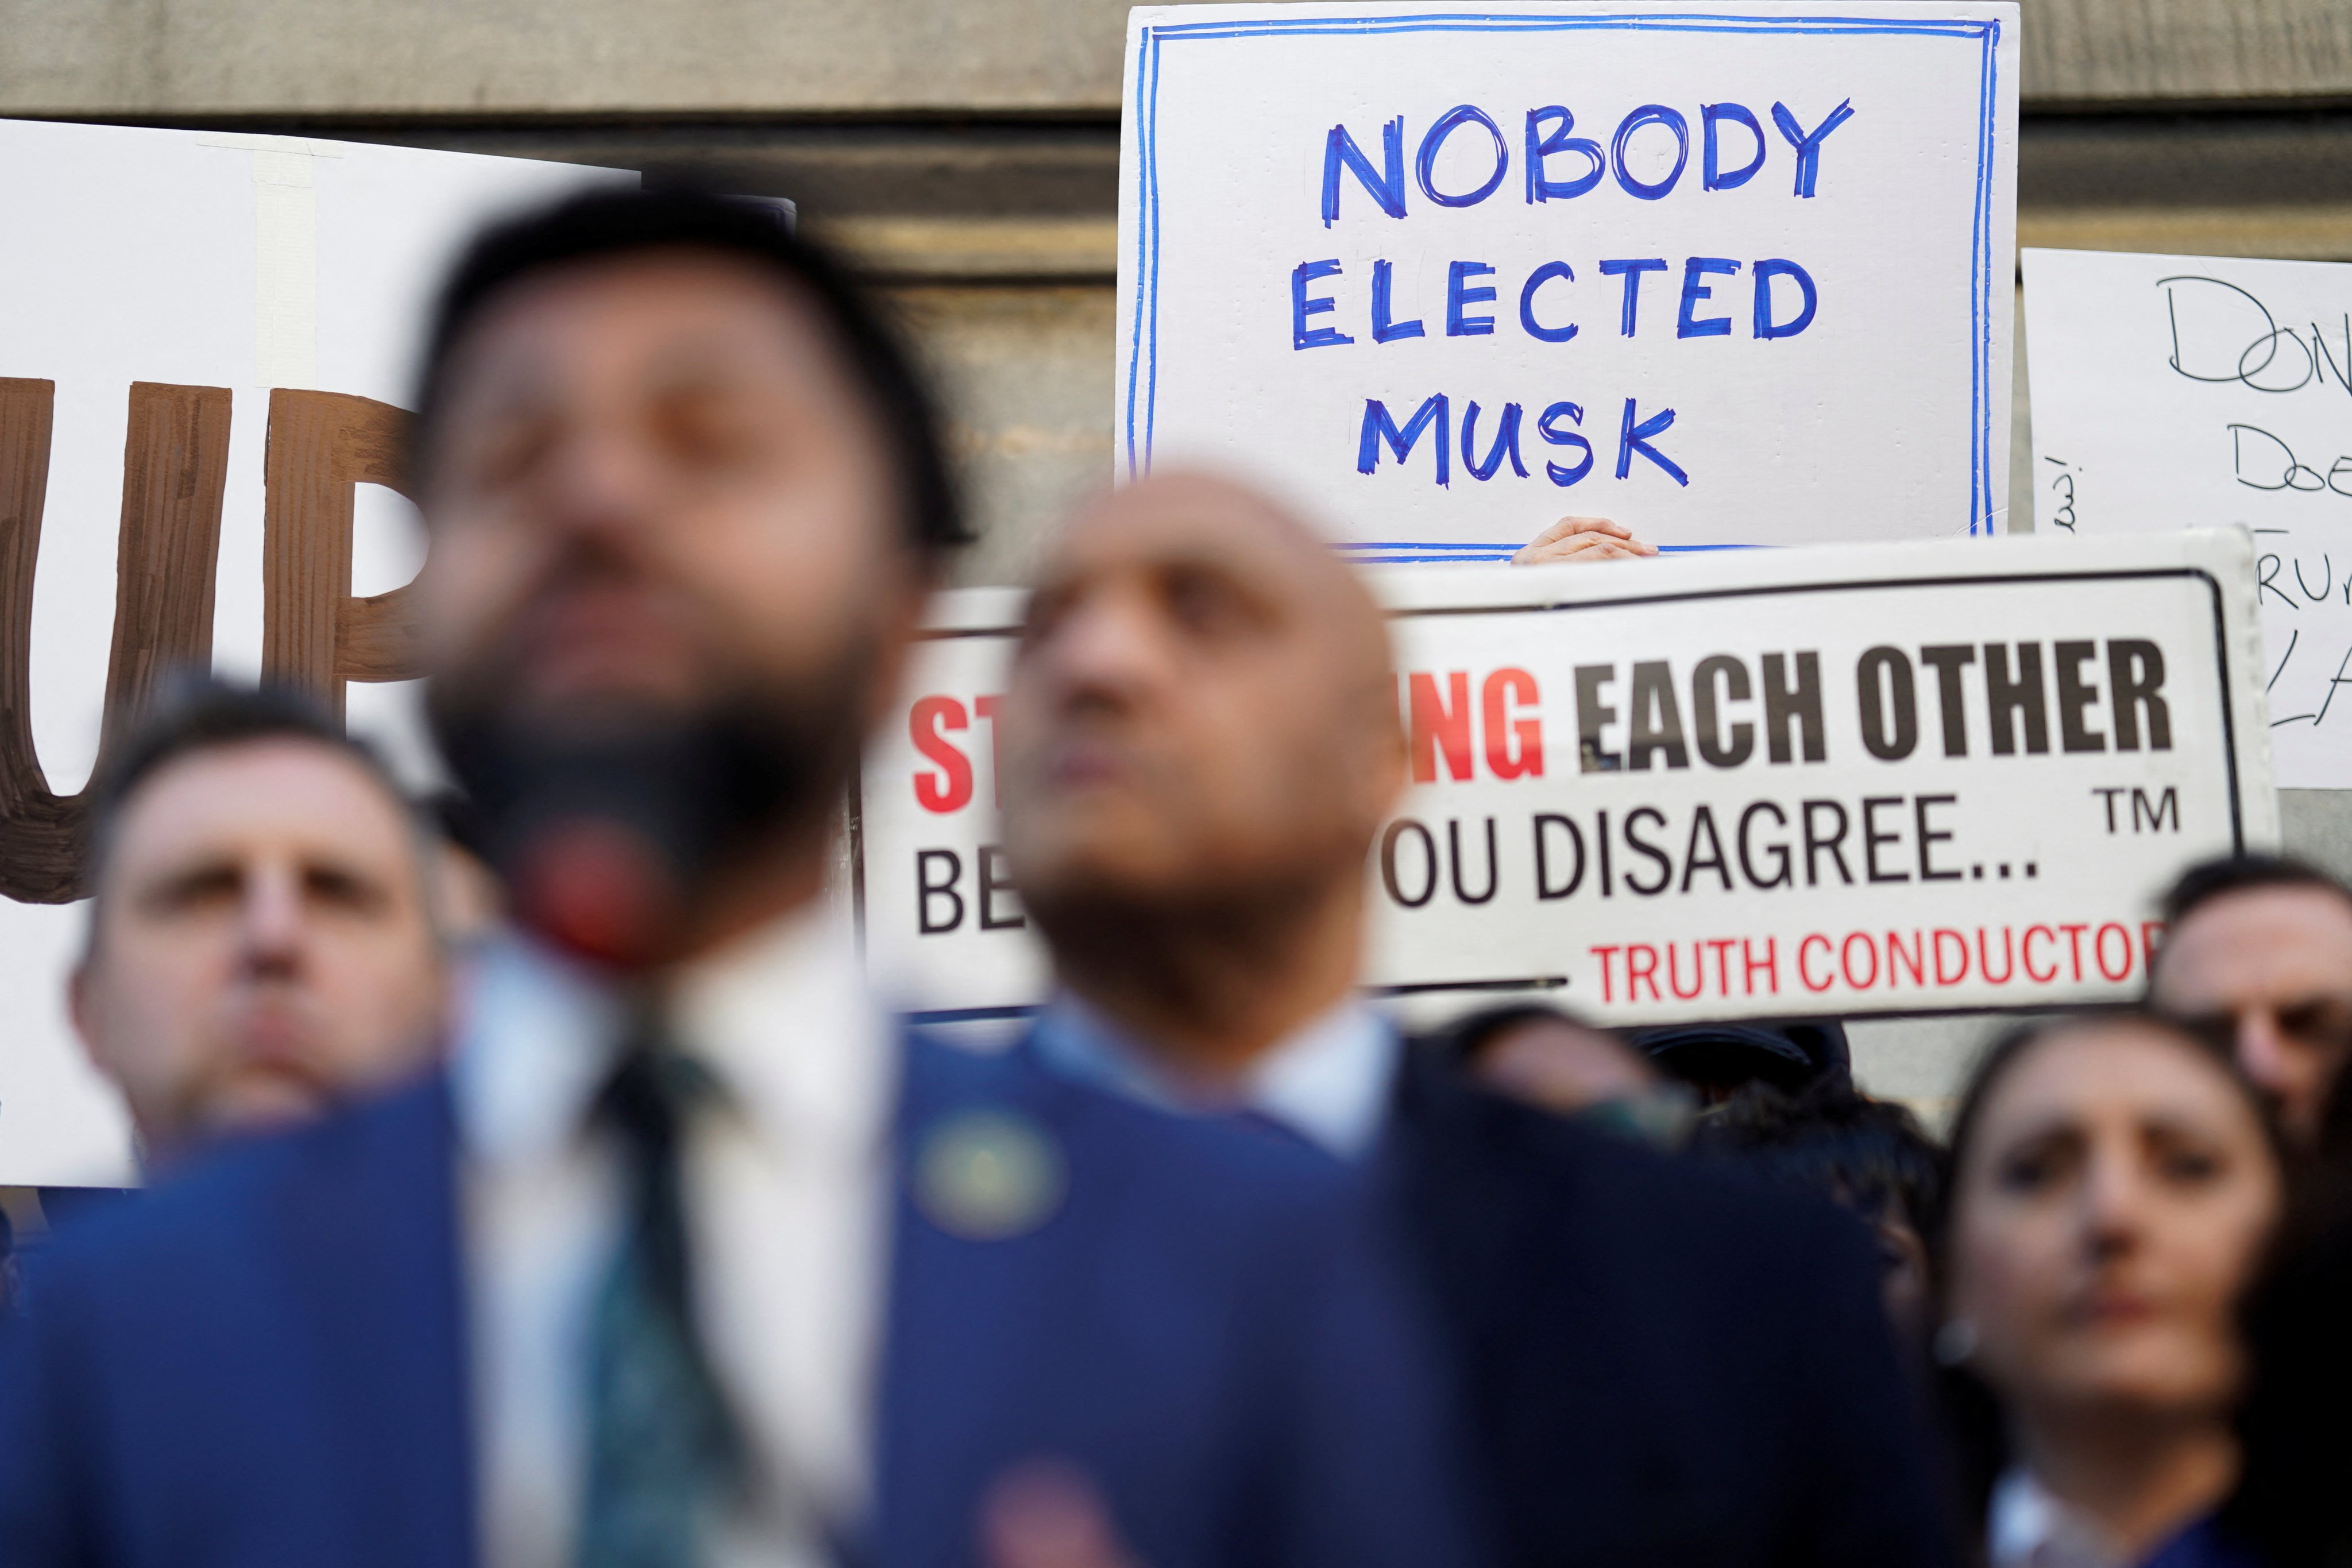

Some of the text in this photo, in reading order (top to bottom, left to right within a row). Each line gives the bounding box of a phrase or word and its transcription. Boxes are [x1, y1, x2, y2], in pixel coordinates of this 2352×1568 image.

[1322, 97, 1855, 230] NOBODY
[1291, 256, 1818, 352] ELECTED
[1357, 392, 1690, 490] MUSK
[1392, 667, 1545, 785] NG
[1574, 651, 1828, 774] EACH
[1856, 638, 2174, 763] OTHER
[1381, 814, 1499, 909] OU
[1532, 794, 2038, 902] DISAGREE...
[2092, 786, 2181, 835] TM
[1589, 936, 1779, 1004] TRUTH
